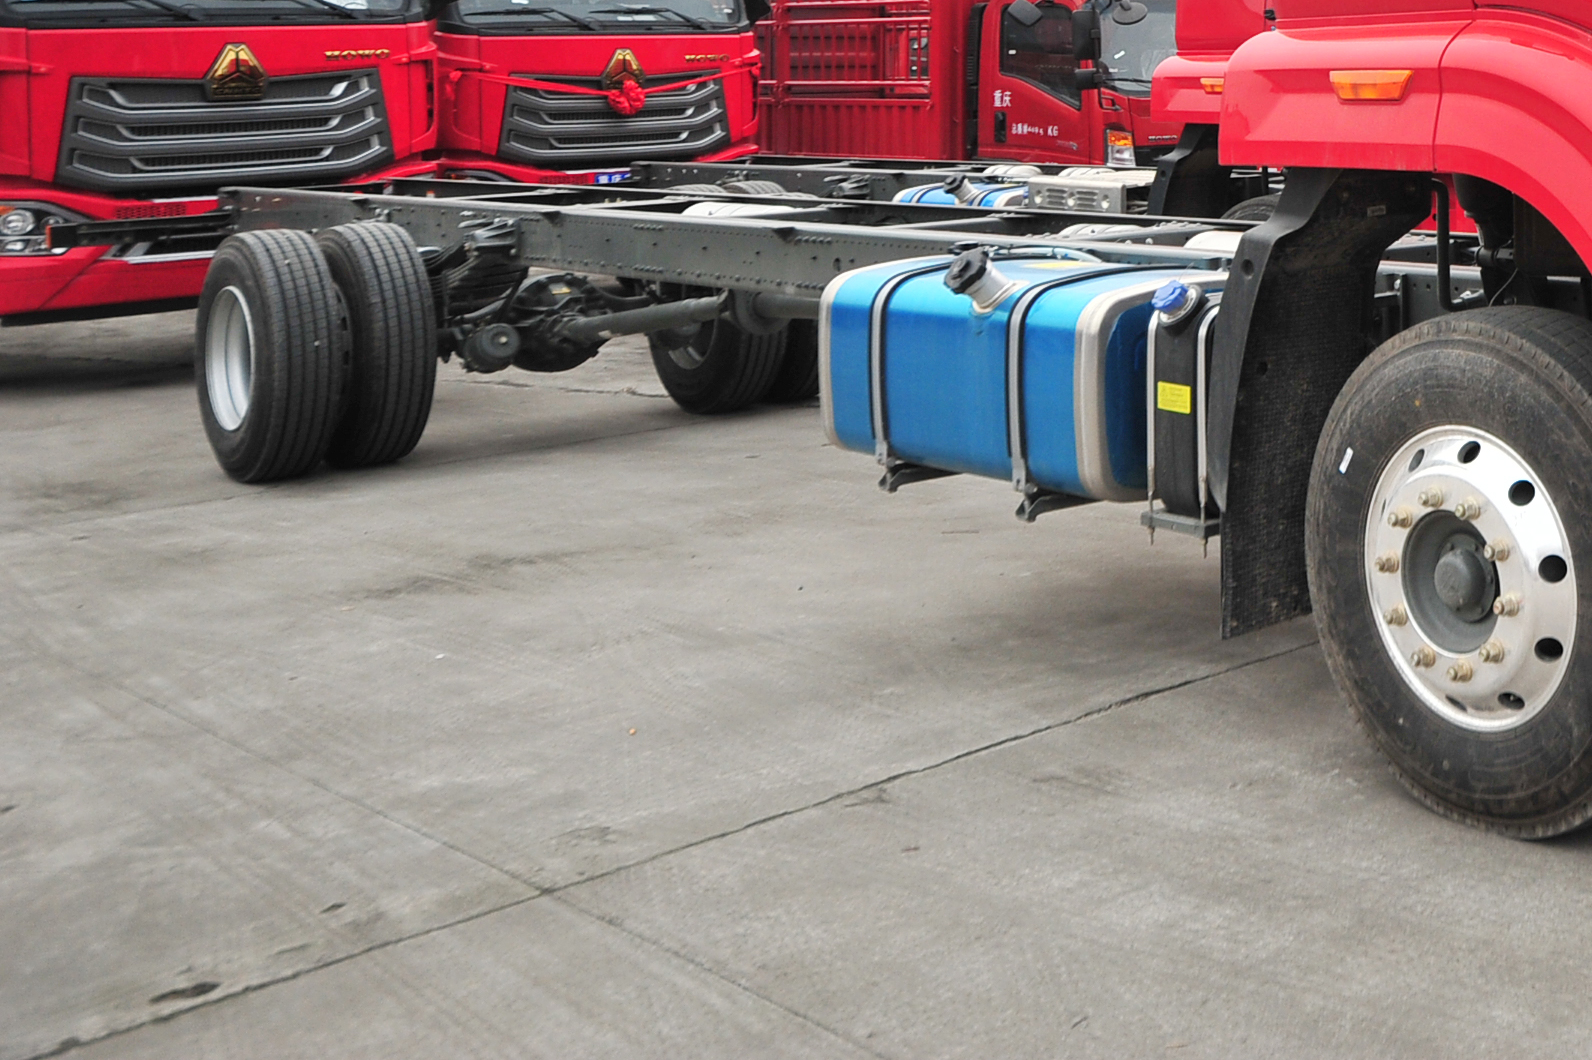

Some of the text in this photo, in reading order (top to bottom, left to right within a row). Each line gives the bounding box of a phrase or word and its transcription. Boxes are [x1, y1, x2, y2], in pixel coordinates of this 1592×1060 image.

[324, 48, 391, 61] HOWO
[993, 89, 1012, 107] 重庆
[1047, 125, 1059, 137] KG
